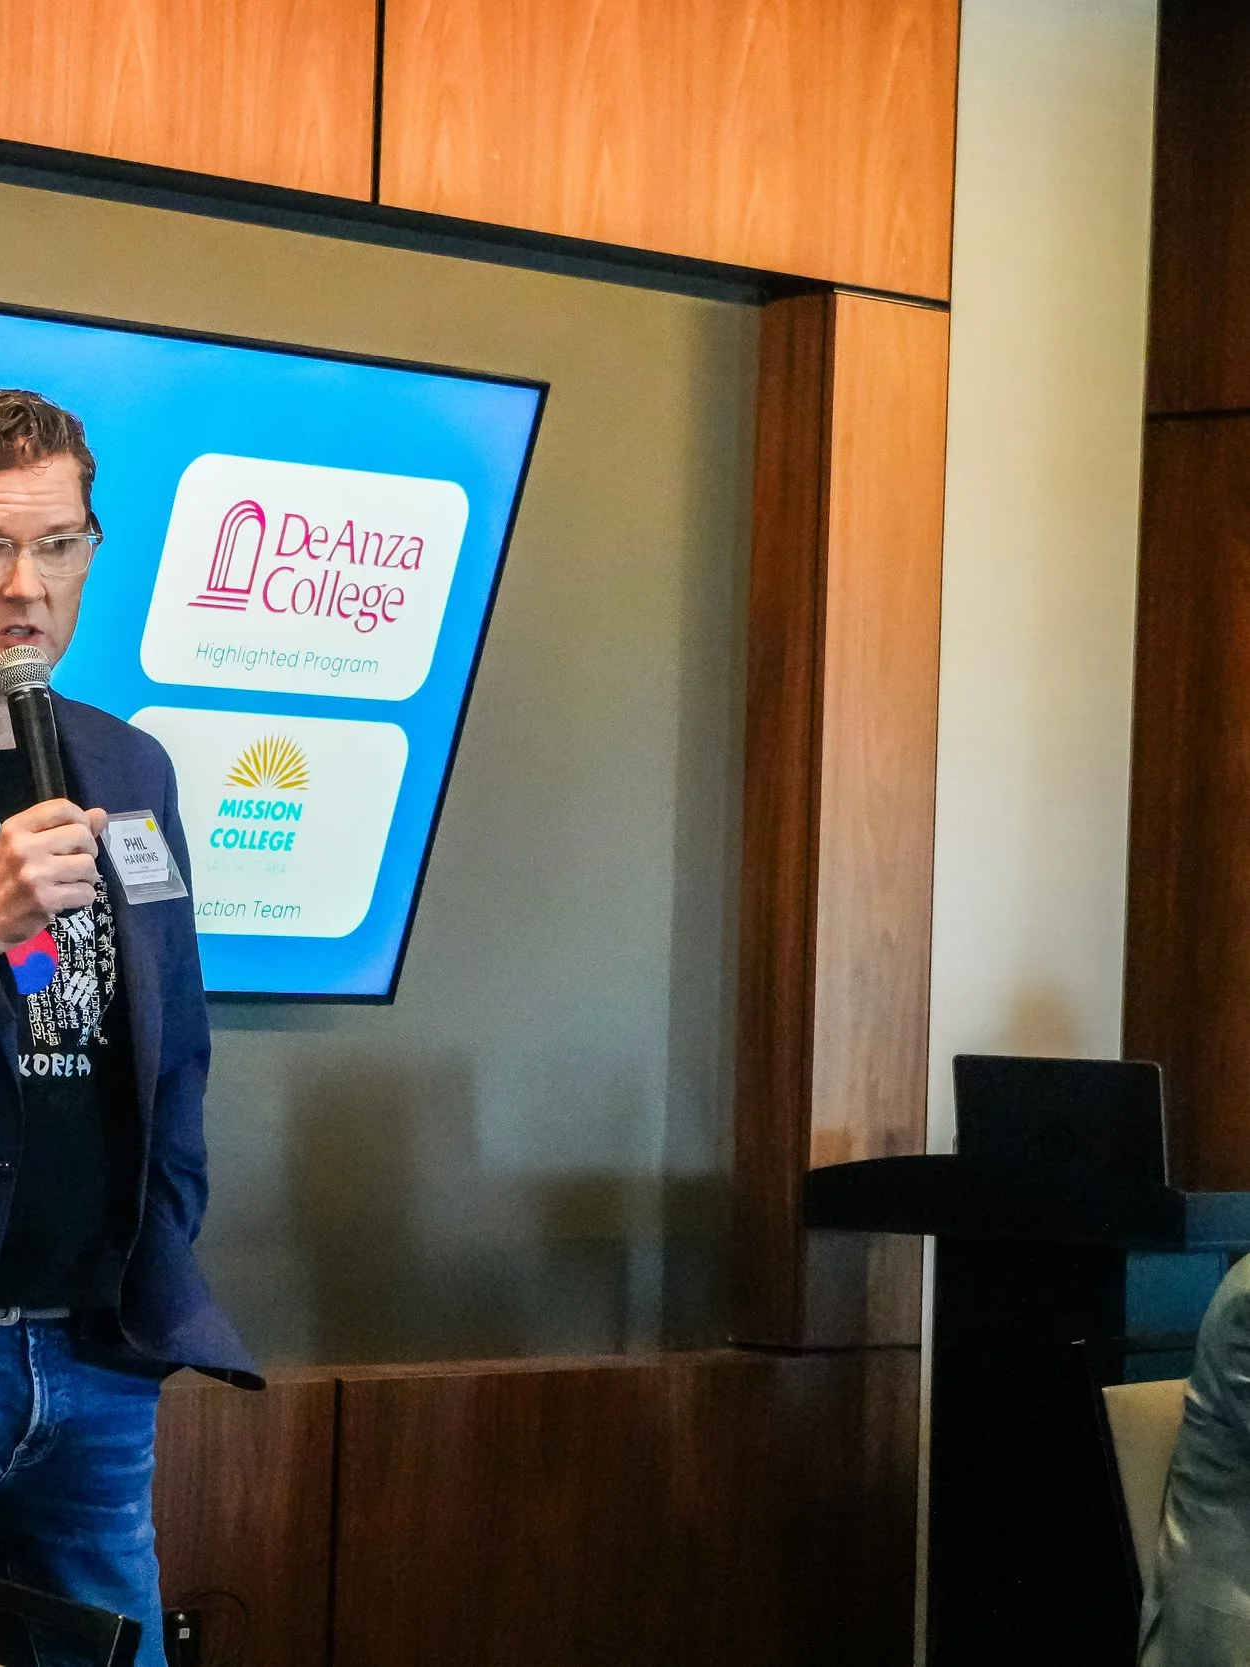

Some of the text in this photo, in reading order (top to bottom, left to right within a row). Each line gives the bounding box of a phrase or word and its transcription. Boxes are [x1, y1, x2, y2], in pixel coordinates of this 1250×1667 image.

[262, 566, 405, 633] College
[196, 642, 379, 678] Highlighted Program
[217, 798, 303, 822] MISSION
[123, 836, 148, 852] PHIL
[209, 828, 297, 852] COLLEGE
[123, 852, 160, 865] HAWKINS
[252, 900, 301, 920] Team
[18, 1053, 92, 1078] KOREA
